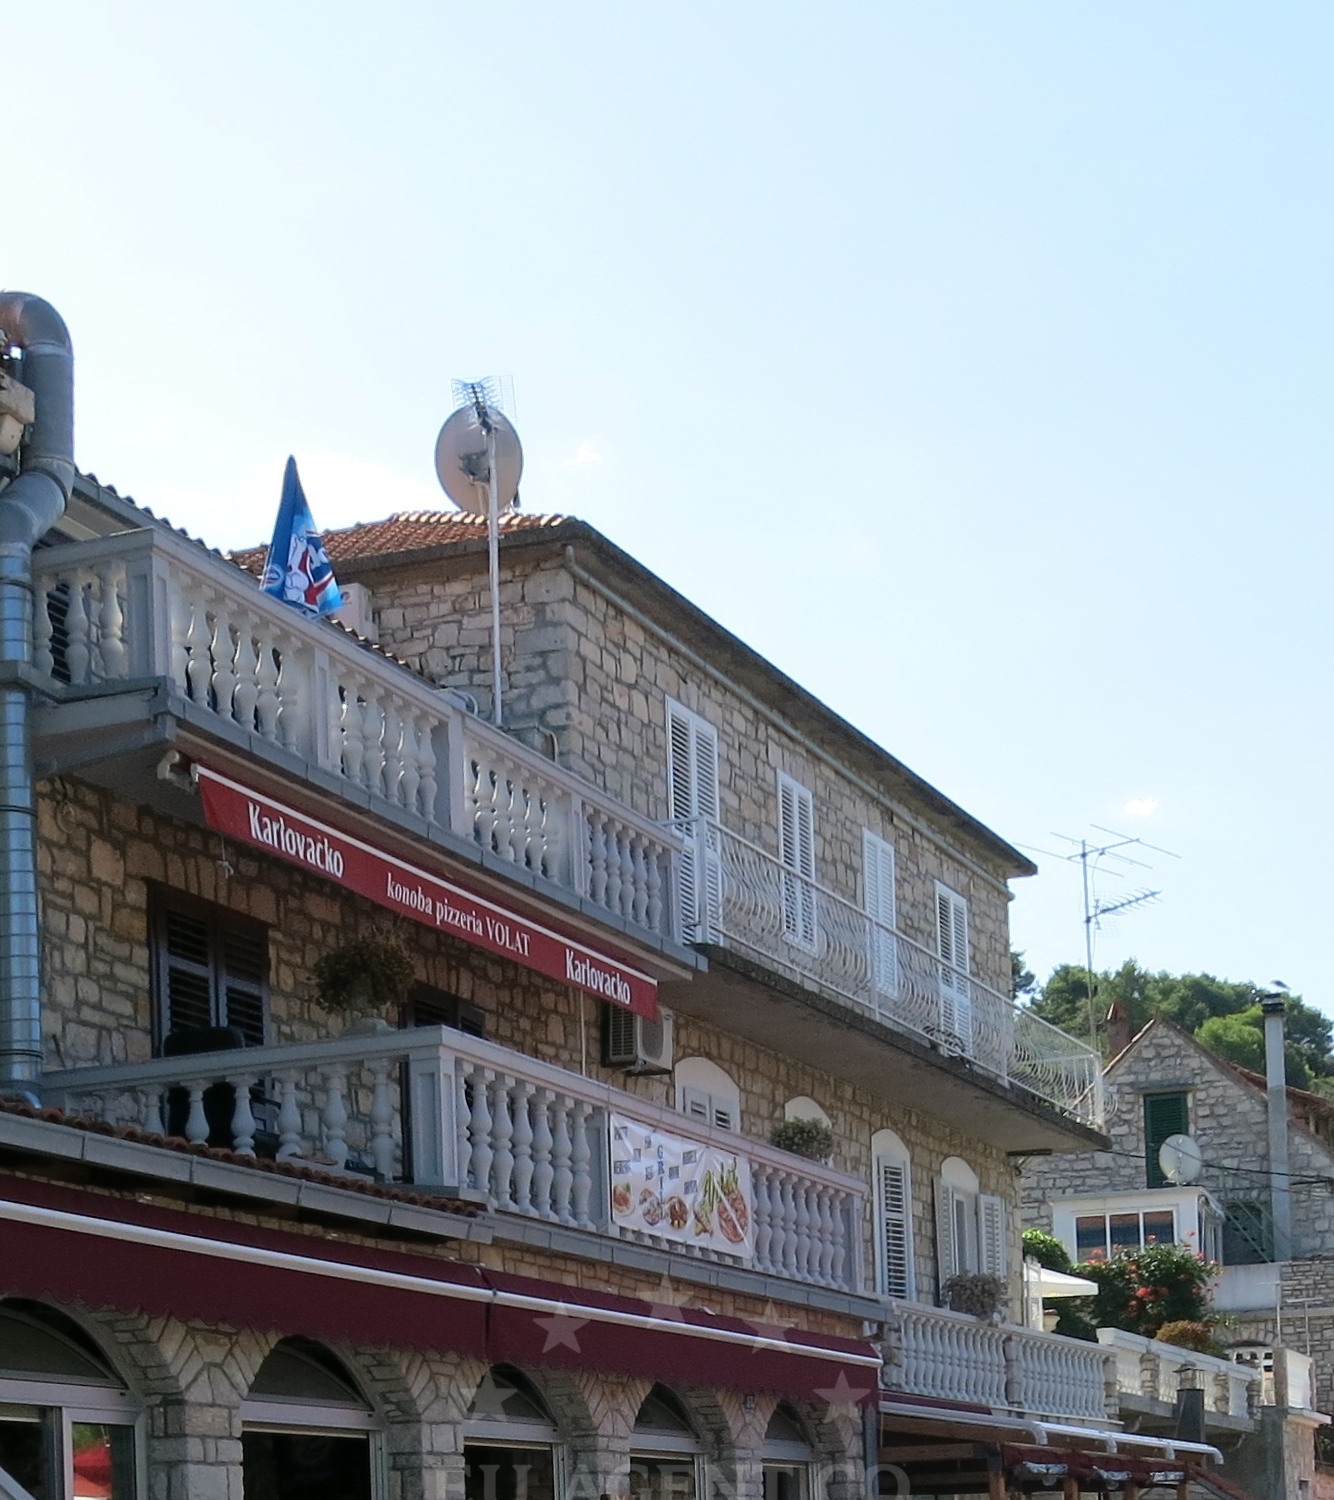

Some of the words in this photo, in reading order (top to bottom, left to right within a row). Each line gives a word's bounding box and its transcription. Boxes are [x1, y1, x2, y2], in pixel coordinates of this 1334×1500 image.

[387, 872, 433, 916] konoba
[436, 898, 483, 936] pizzeria
[486, 916, 531, 957] VOLAT
